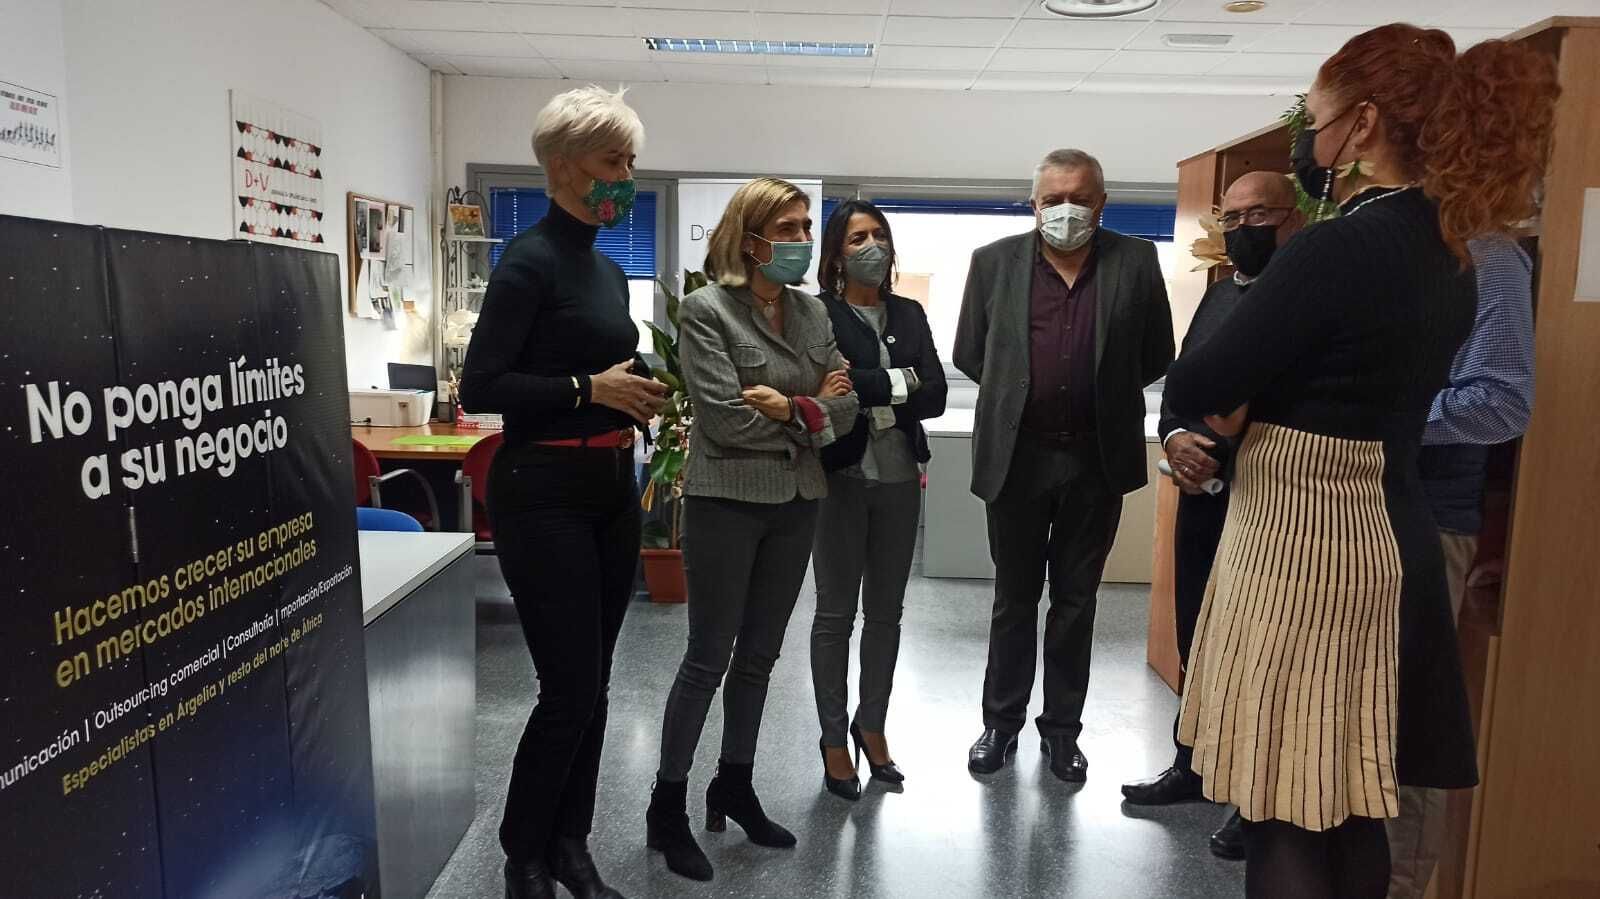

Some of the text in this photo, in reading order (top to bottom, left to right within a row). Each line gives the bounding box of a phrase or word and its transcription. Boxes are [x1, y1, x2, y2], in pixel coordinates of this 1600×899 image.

[25, 355, 305, 443] No ponga límites
[81, 409, 288, 500] a su negocio
[54, 575, 170, 645] Hacemos
[175, 545, 232, 590] crecer
[236, 537, 254, 562] su
[56, 539, 317, 687] en mercados internacionales
[95, 679, 168, 730] Outsourcing
[170, 643, 220, 686] comercial
[226, 613, 274, 651] Consultoría
[280, 564, 353, 620] mportación/Exportación
[62, 724, 157, 795] Especialistas
[158, 712, 174, 732] en
[218, 677, 225, 696] y
[227, 662, 251, 687] resto
[253, 651, 268, 669] del
[290, 627, 301, 643] de
